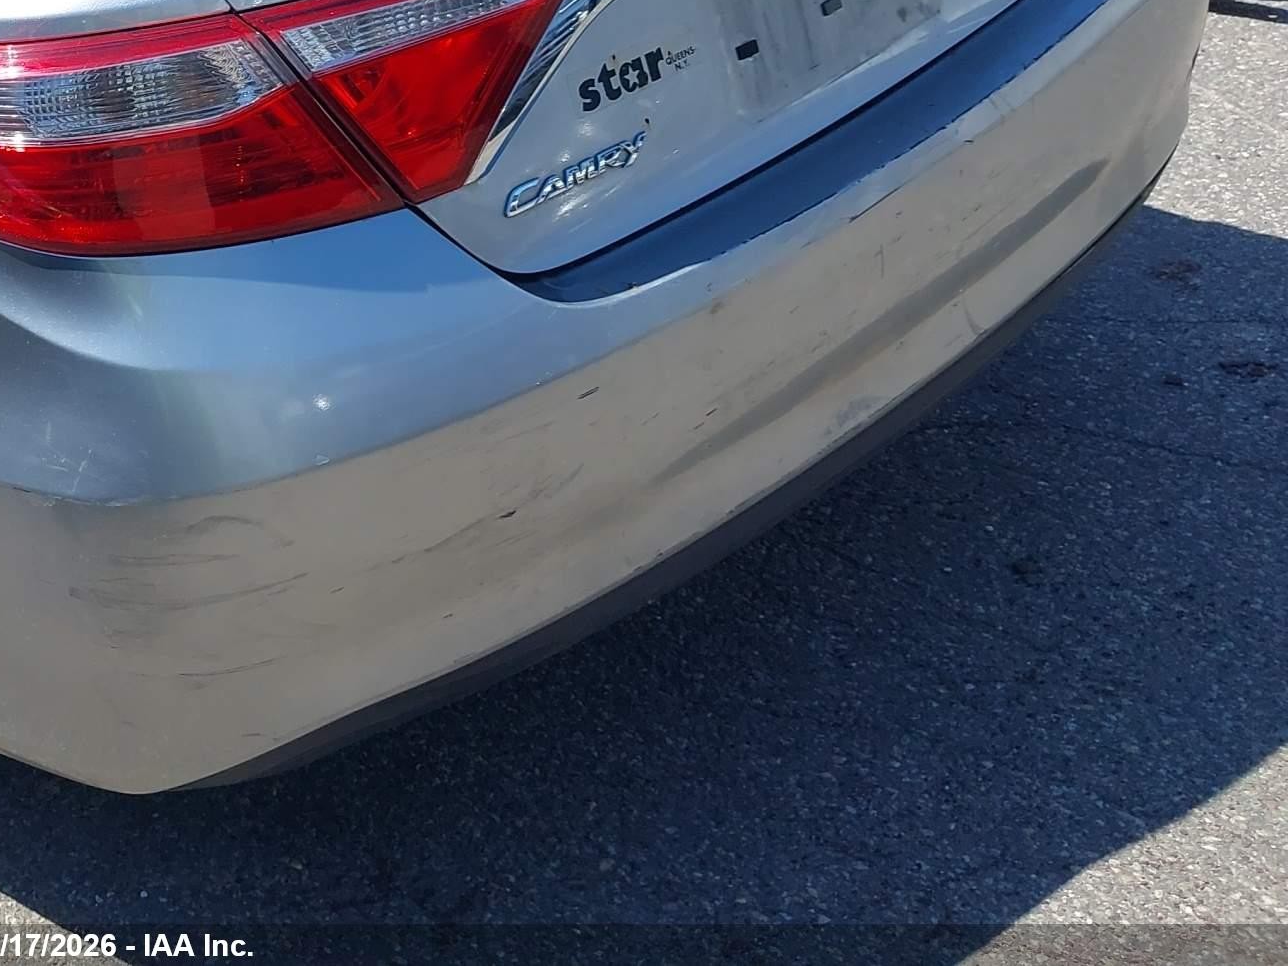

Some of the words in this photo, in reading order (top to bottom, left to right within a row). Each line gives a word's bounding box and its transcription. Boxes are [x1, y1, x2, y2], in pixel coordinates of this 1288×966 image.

[578, 47, 664, 112] star
[665, 46, 695, 66] QUEENS
[503, 130, 648, 218] CAMRY
